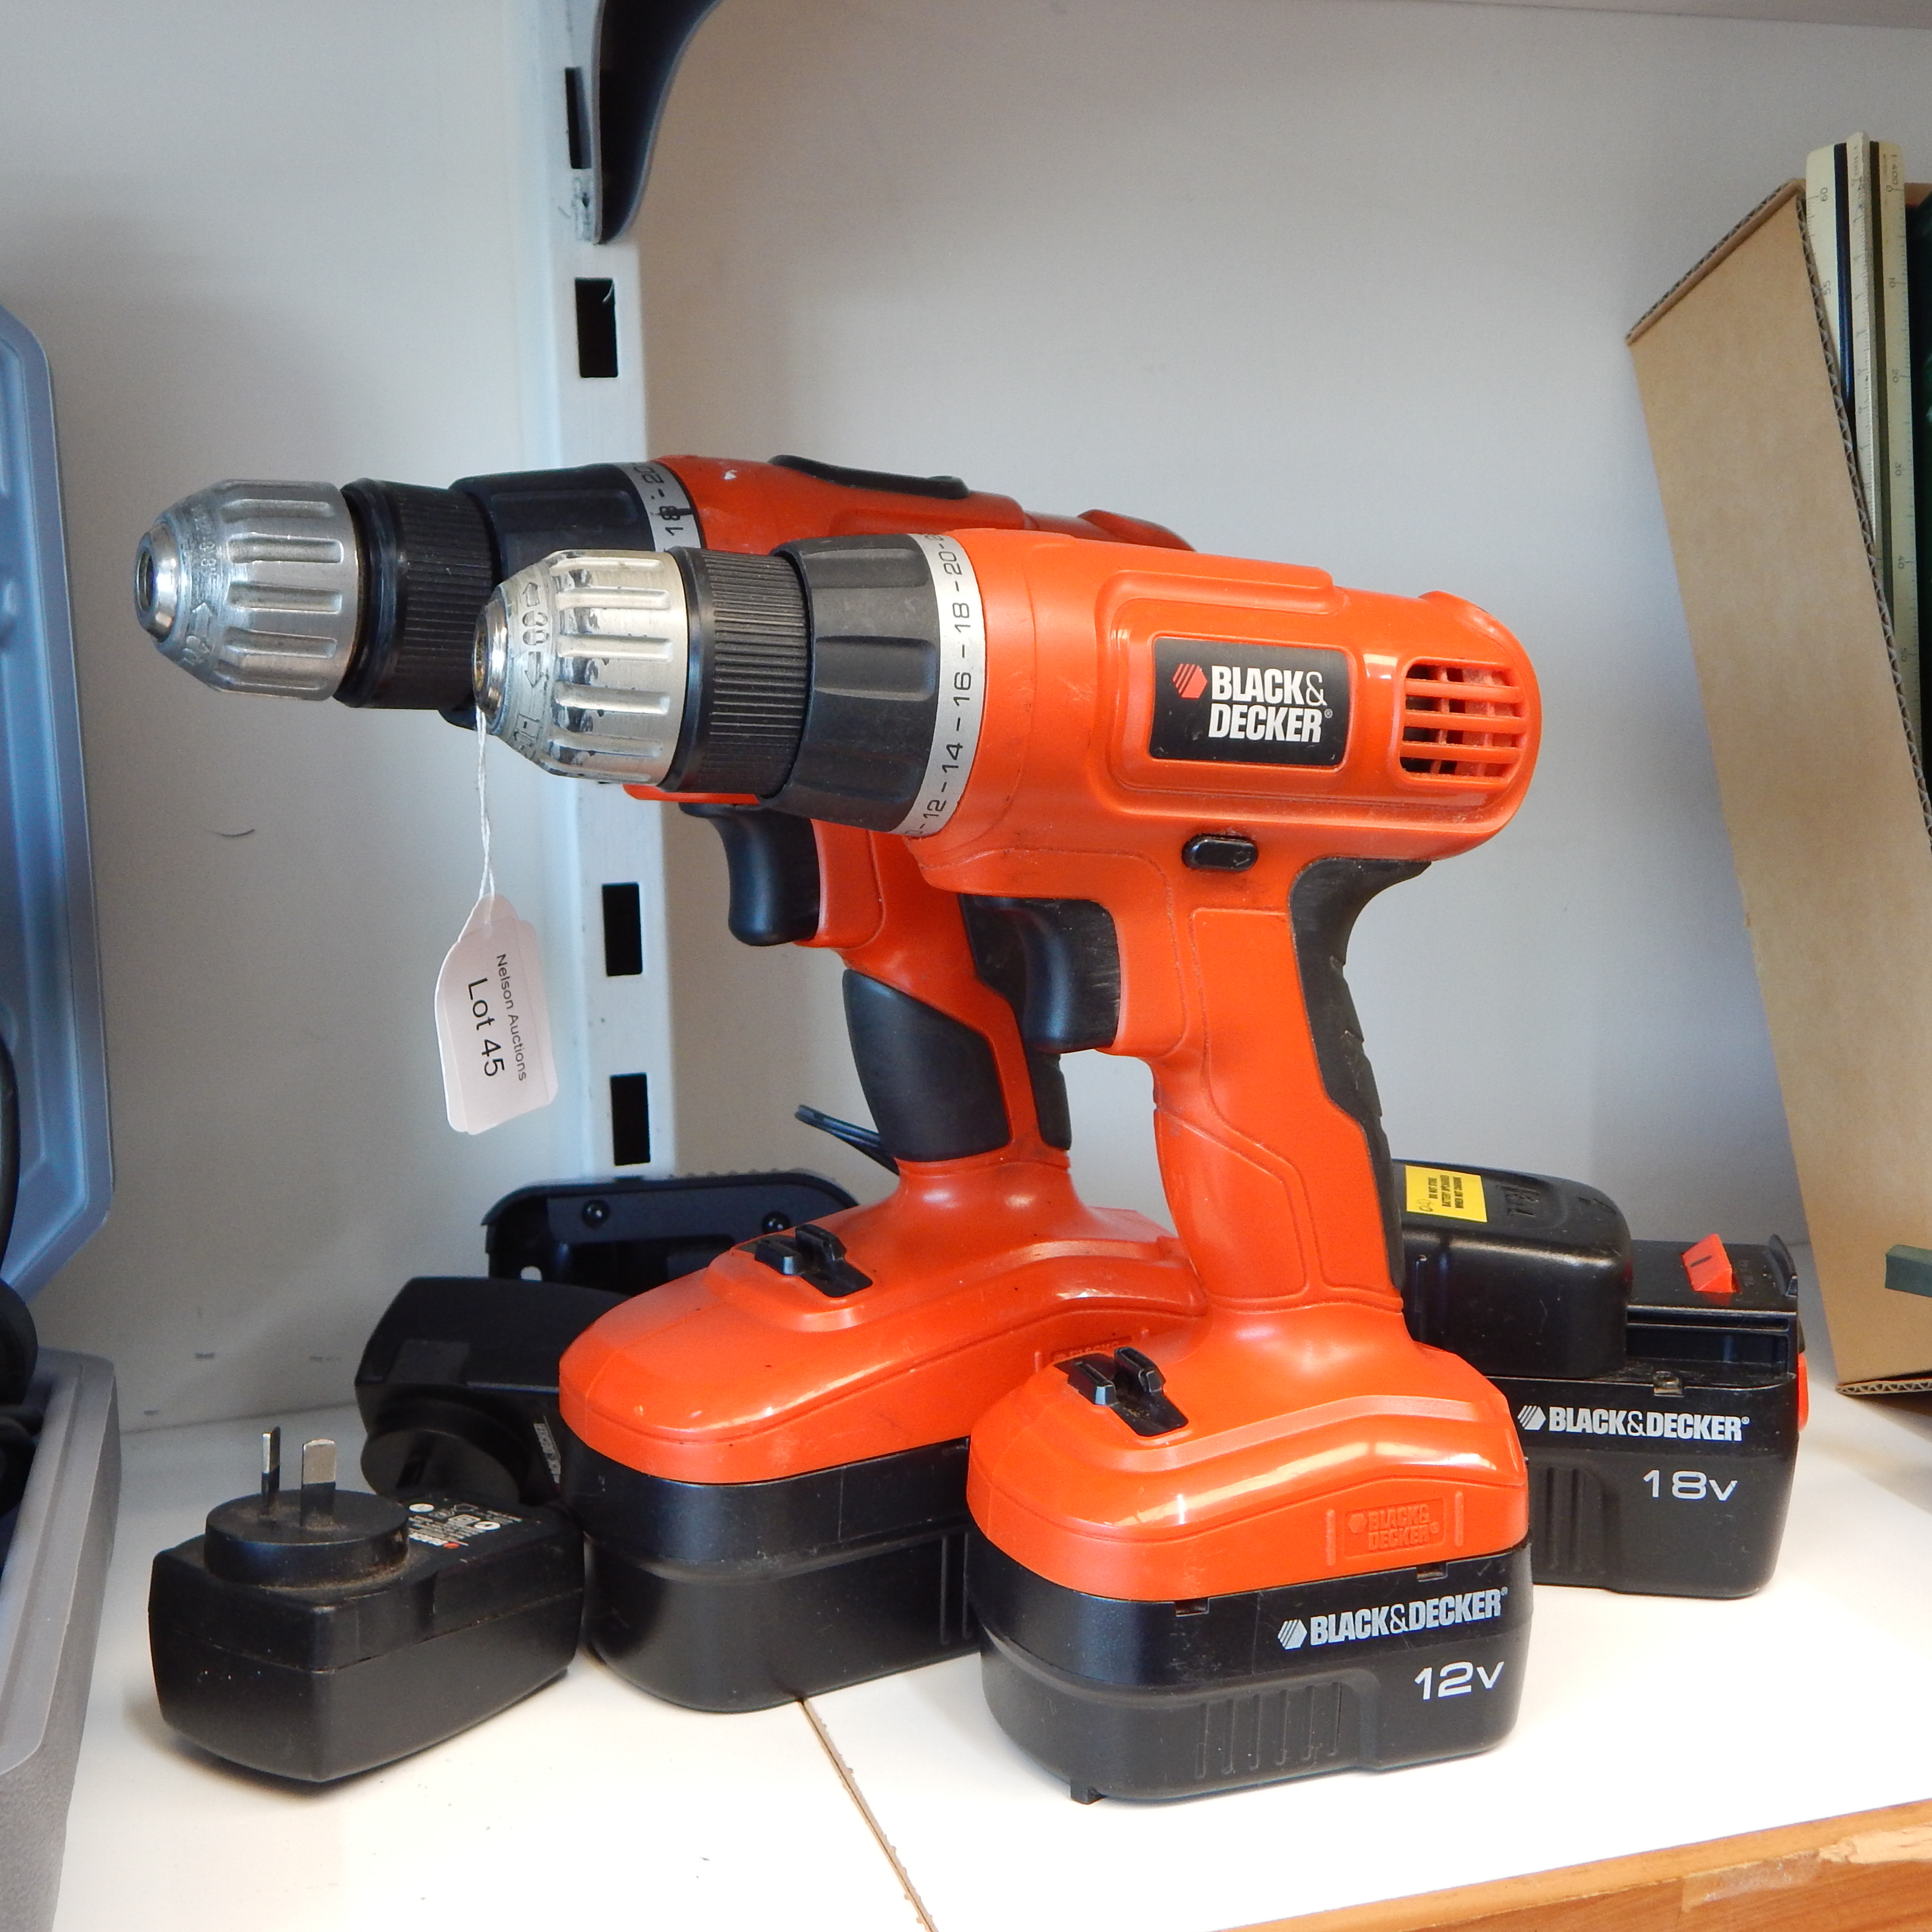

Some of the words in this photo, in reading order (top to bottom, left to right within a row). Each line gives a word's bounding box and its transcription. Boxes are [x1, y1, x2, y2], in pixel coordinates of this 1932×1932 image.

[1820, 187, 1828, 202] 60
[938, 551, 962, 575] 20
[952, 602, 971, 633] 18
[953, 671, 972, 706] 16
[1211, 665, 1328, 707] BLACK&
[1208, 702, 1323, 743] DECKER
[942, 743, 963, 773] 14
[923, 799, 947, 819] 12
[467, 977, 495, 1031] Lot
[481, 1039, 505, 1077] 45
[496, 953, 514, 1010] Nelson
[507, 1014, 527, 1081] Auctions
[1549, 1406, 1742, 1442] BLACK&DECKER
[1310, 1588, 1502, 1646] BLACK&DECKER
